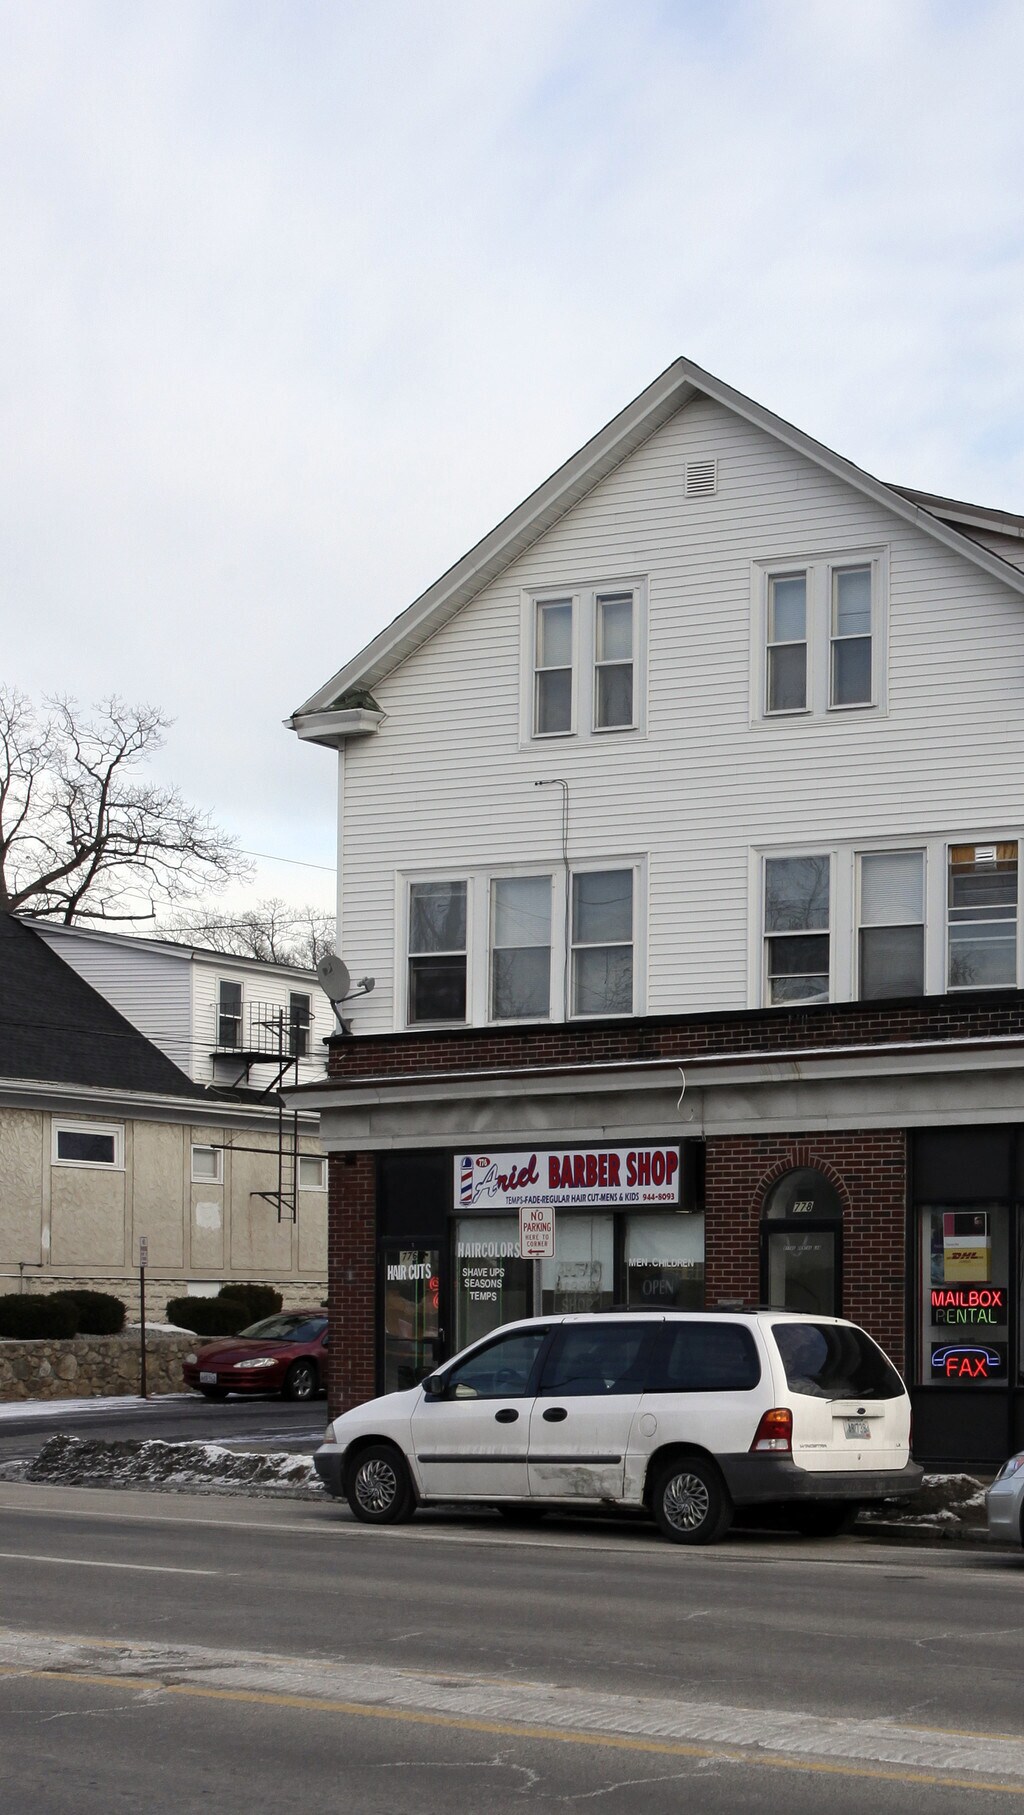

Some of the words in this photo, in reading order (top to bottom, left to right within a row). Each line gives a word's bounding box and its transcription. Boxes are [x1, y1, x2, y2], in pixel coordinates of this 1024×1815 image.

[473, 1154, 540, 1204] Ariel
[549, 1153, 621, 1189] BARBER
[626, 1150, 679, 1187] SHOP
[571, 1193, 587, 1203] HAIR
[618, 1192, 624, 1202] &
[624, 1192, 640, 1201] KIDS
[642, 1192, 675, 1201] 944-8093
[794, 1202, 813, 1212] 778
[530, 1211, 544, 1221] NO
[523, 1222, 552, 1232] PARKING
[457, 1241, 520, 1258] HAIRCOLORS
[402, 1251, 418, 1262] 776
[952, 1252, 982, 1260] DHL
[387, 1264, 407, 1281] HAIR
[408, 1263, 431, 1280] CUTS
[462, 1268, 488, 1277] SHAVE
[489, 1267, 505, 1277] UPS
[464, 1278, 503, 1288] SEASONS
[642, 1279, 674, 1296] OPEN
[469, 1291, 497, 1301] TEMPS
[931, 1290, 1003, 1307] MAILBOX
[936, 1308, 997, 1324] RENTAL
[946, 1358, 988, 1377] FAX
